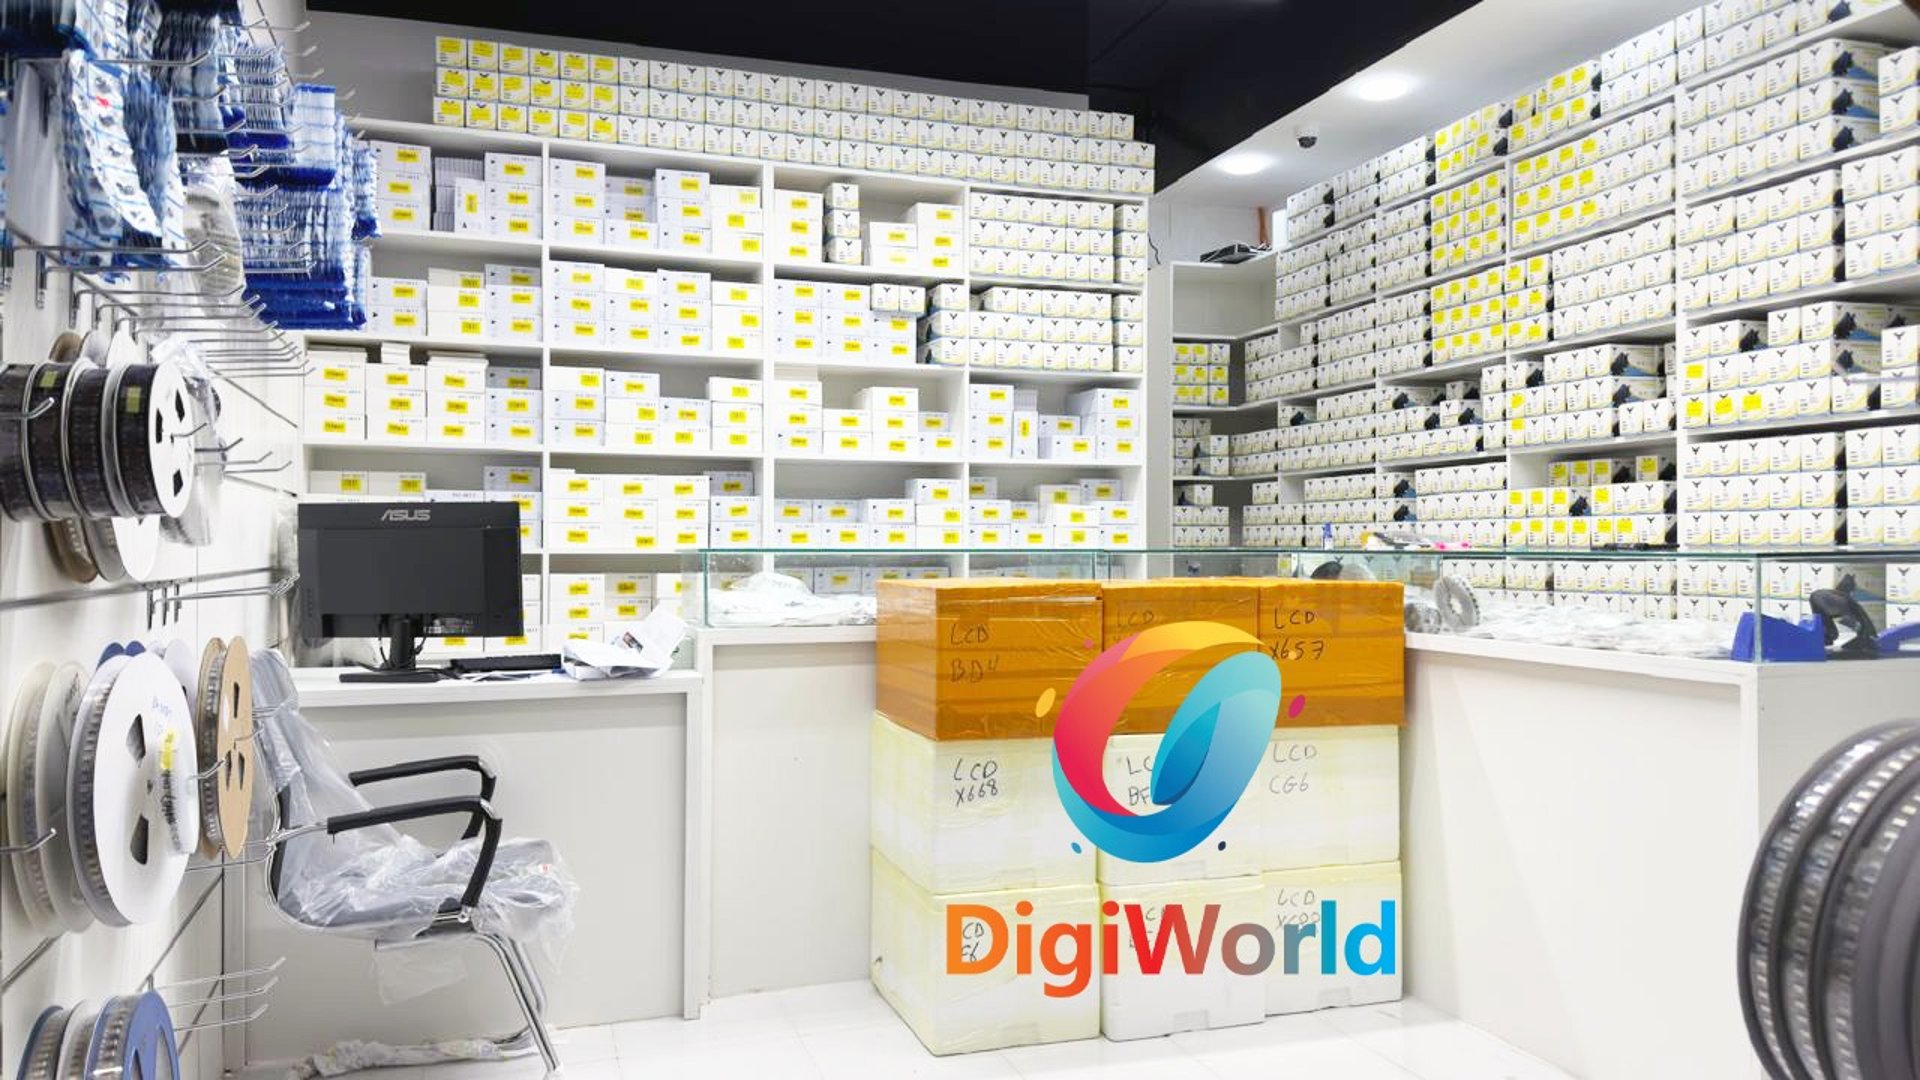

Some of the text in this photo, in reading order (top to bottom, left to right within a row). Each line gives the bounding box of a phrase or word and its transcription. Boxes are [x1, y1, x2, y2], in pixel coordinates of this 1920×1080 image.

[381, 509, 431, 521] ASUS
[1275, 608, 1315, 629] LCD
[951, 623, 989, 645] LCD
[1273, 744, 1318, 763] LCD
[953, 758, 998, 781] LCD
[1126, 755, 1152, 775] LC
[955, 778, 998, 807] X668
[1269, 771, 1309, 794] CG6
[1277, 887, 1316, 906] LCD
[961, 922, 985, 939] CD
